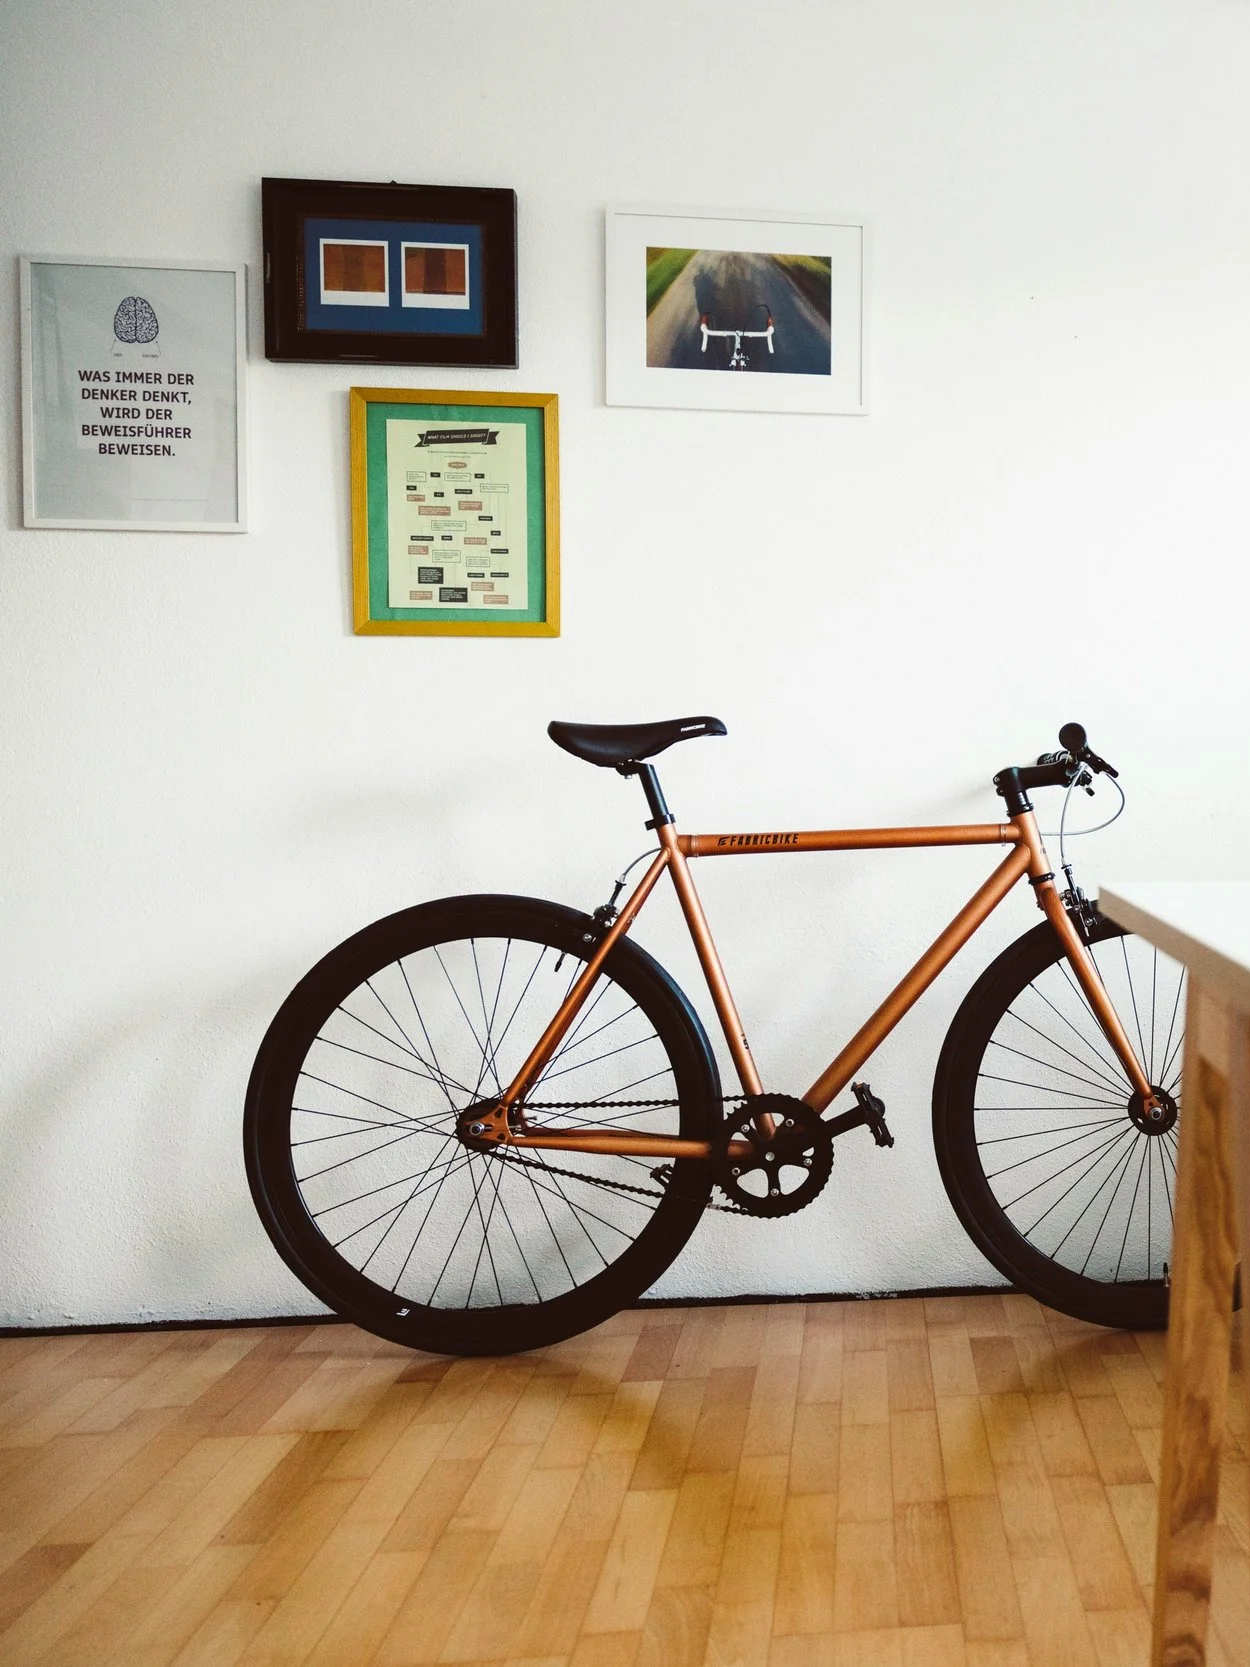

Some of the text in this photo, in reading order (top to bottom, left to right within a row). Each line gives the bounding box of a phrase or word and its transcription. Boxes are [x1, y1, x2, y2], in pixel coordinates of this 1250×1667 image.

[78, 370, 194, 385] WAS IMMER DER
[81, 388, 192, 405] DENKER DENKT,
[100, 407, 172, 420] WIRD DER
[81, 424, 192, 439] BEWEISFÜHRER
[98, 443, 176, 456] BEWEISEN.
[729, 833, 799, 847] FABRICBIKE
